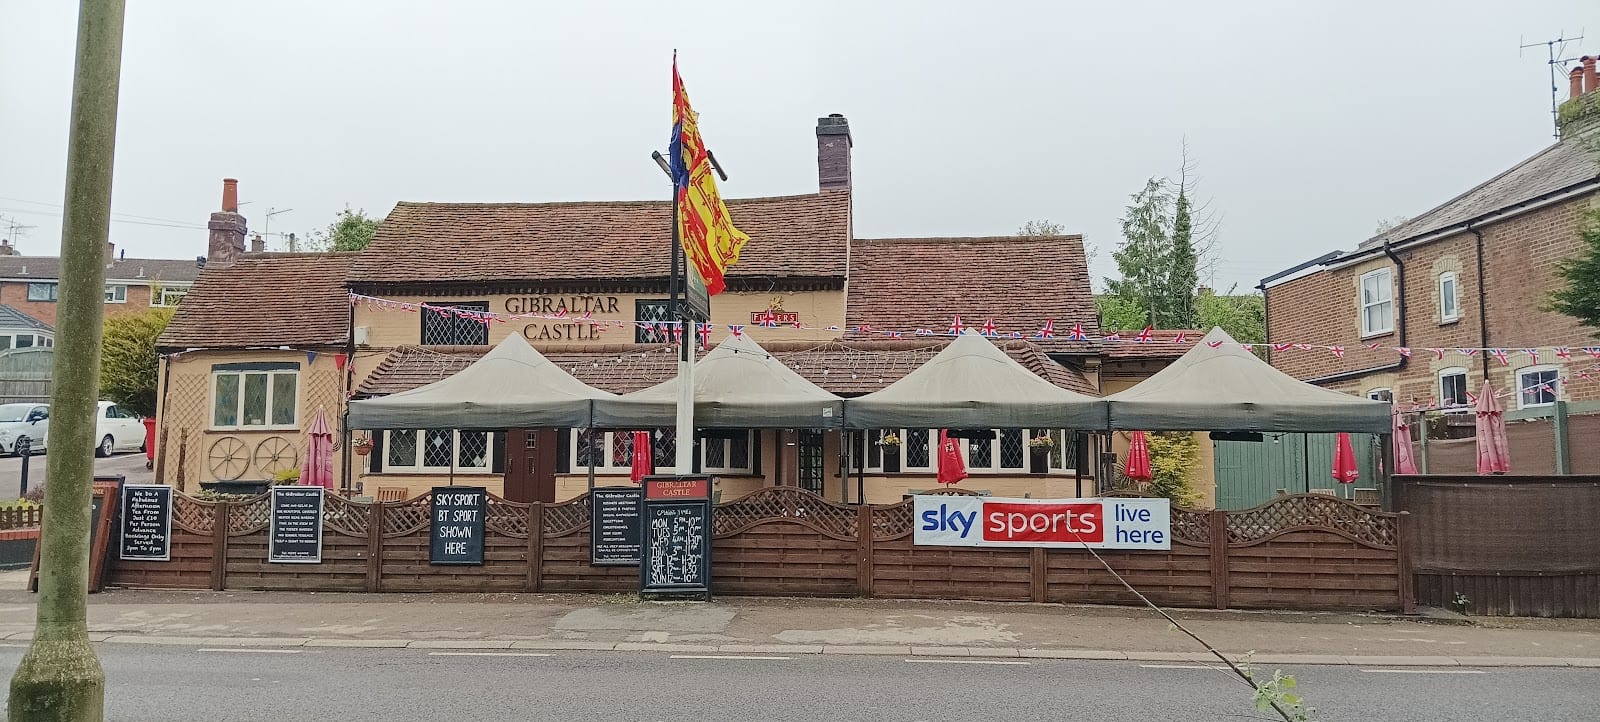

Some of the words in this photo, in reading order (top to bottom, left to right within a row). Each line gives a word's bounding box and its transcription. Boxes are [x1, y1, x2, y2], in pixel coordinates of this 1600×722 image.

[504, 296, 620, 314] GIBRALTAR
[753, 312, 796, 321] FUER'S
[523, 323, 600, 341] CASTLE
[436, 494, 454, 506] SKY
[454, 494, 480, 506] SPORT
[438, 510, 449, 522] BT
[453, 510, 478, 522] SPORT
[1115, 504, 1151, 522] live
[651, 518, 668, 529] MON
[921, 503, 977, 538] sky
[989, 509, 1097, 538] sports
[440, 526, 472, 538] SHOWN
[651, 528, 670, 538] TUES
[1116, 526, 1164, 544] here
[445, 542, 466, 554] HERE
[652, 538, 669, 547] WED
[651, 555, 663, 565] FRI
[651, 575, 666, 584] SUN
